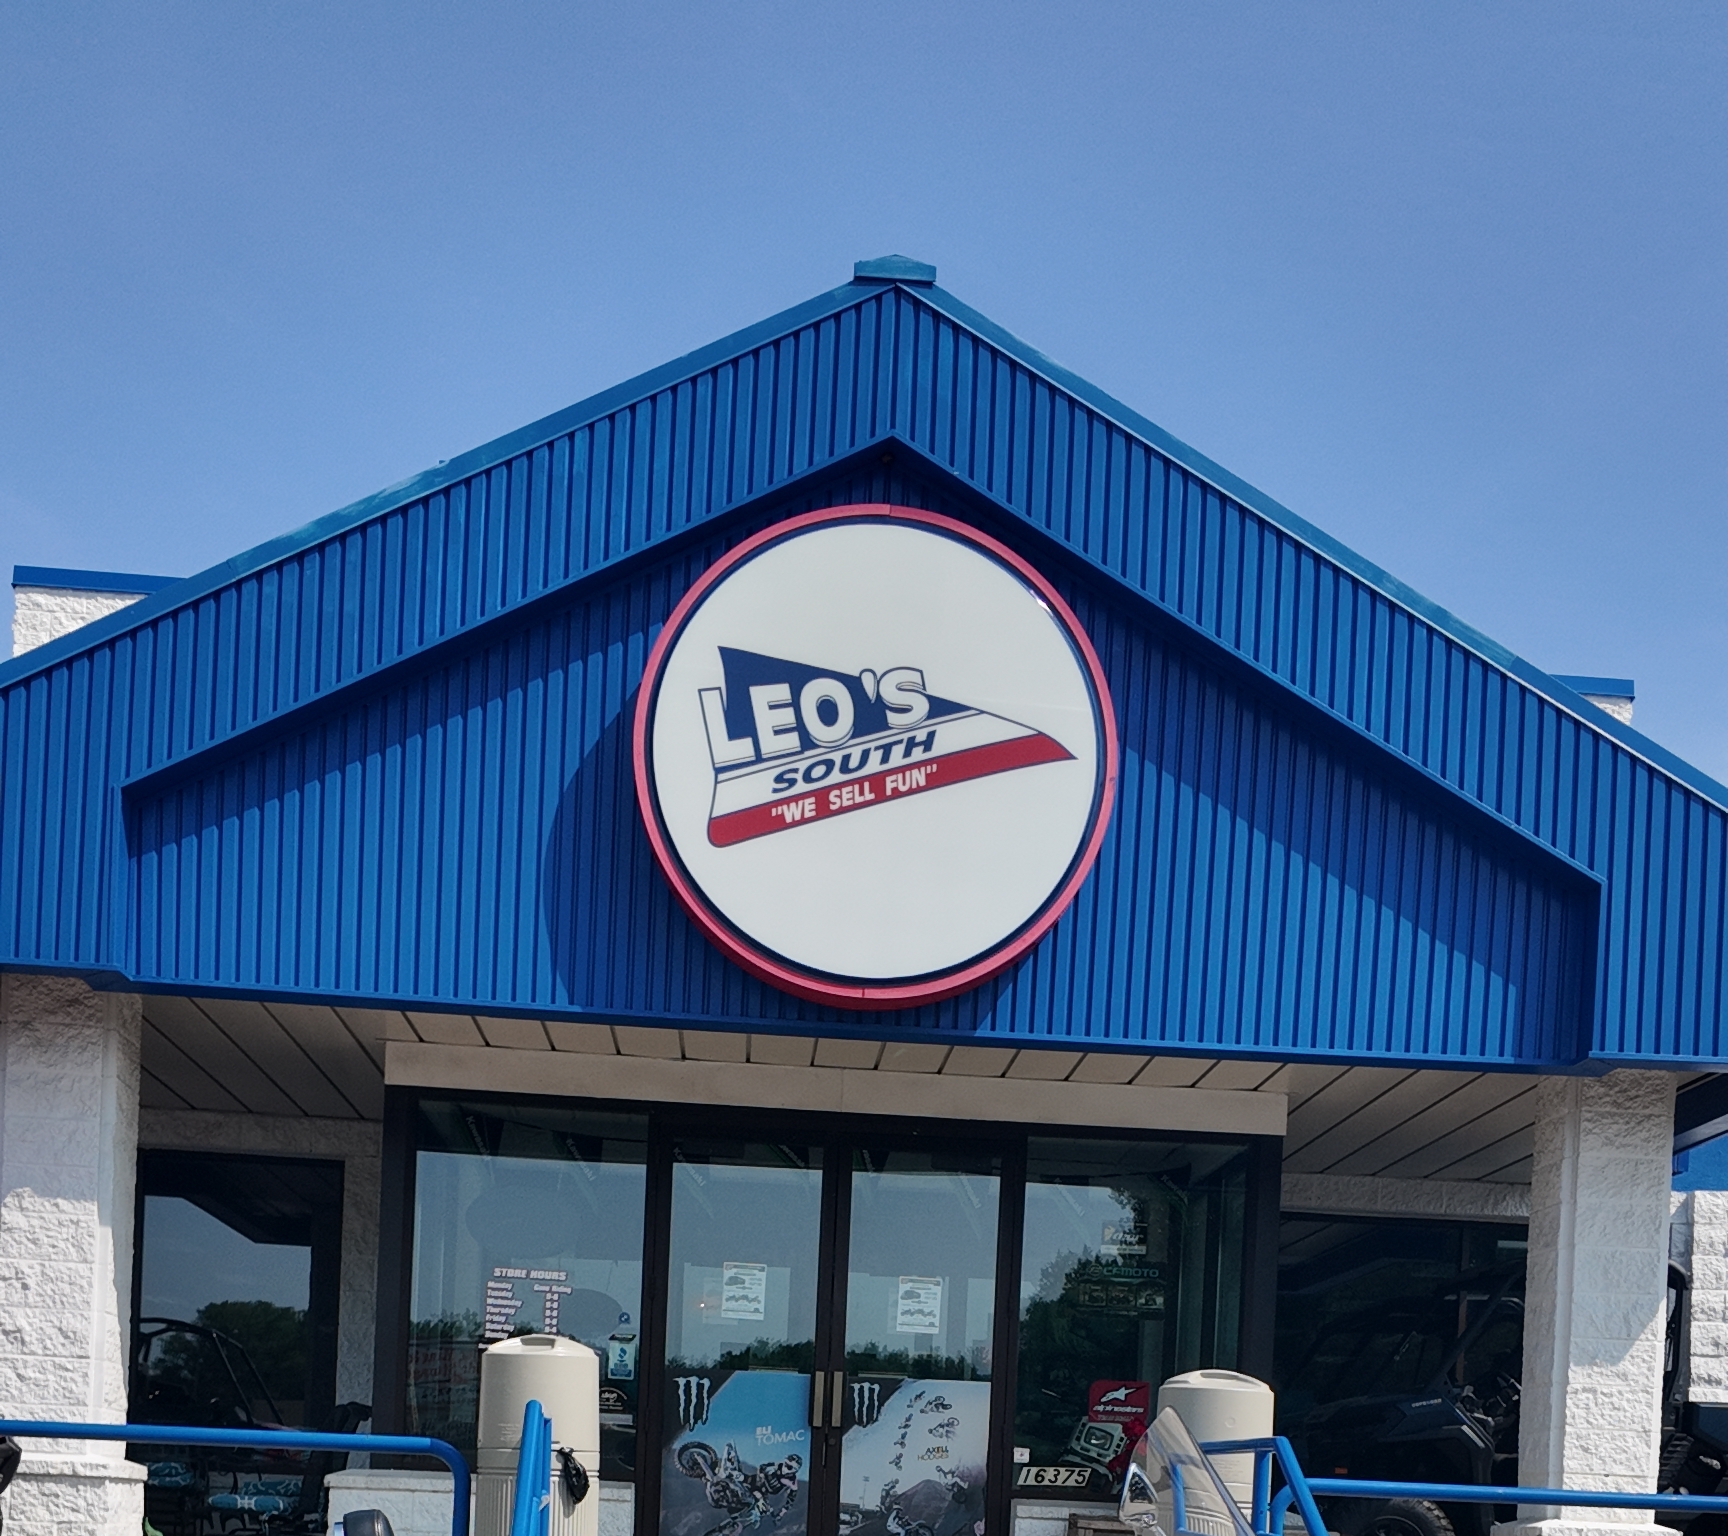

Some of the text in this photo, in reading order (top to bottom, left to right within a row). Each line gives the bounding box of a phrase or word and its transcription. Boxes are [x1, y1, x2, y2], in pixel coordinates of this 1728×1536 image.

[698, 666, 930, 774] LEO'S
[771, 730, 937, 794] SOUTH
[771, 764, 938, 824] "WE SELL FUN"
[493, 1267, 567, 1281] STORE HOURS
[1103, 1267, 1159, 1278] CFMOTO
[486, 1280, 513, 1291] Monday
[486, 1289, 514, 1299] Tuesday
[486, 1298, 523, 1308] Wednesday
[486, 1306, 516, 1316] Thursday
[485, 1314, 507, 1323] Friday
[755, 1429, 805, 1446] TOMAC
[1023, 1468, 1089, 1485] 16375
